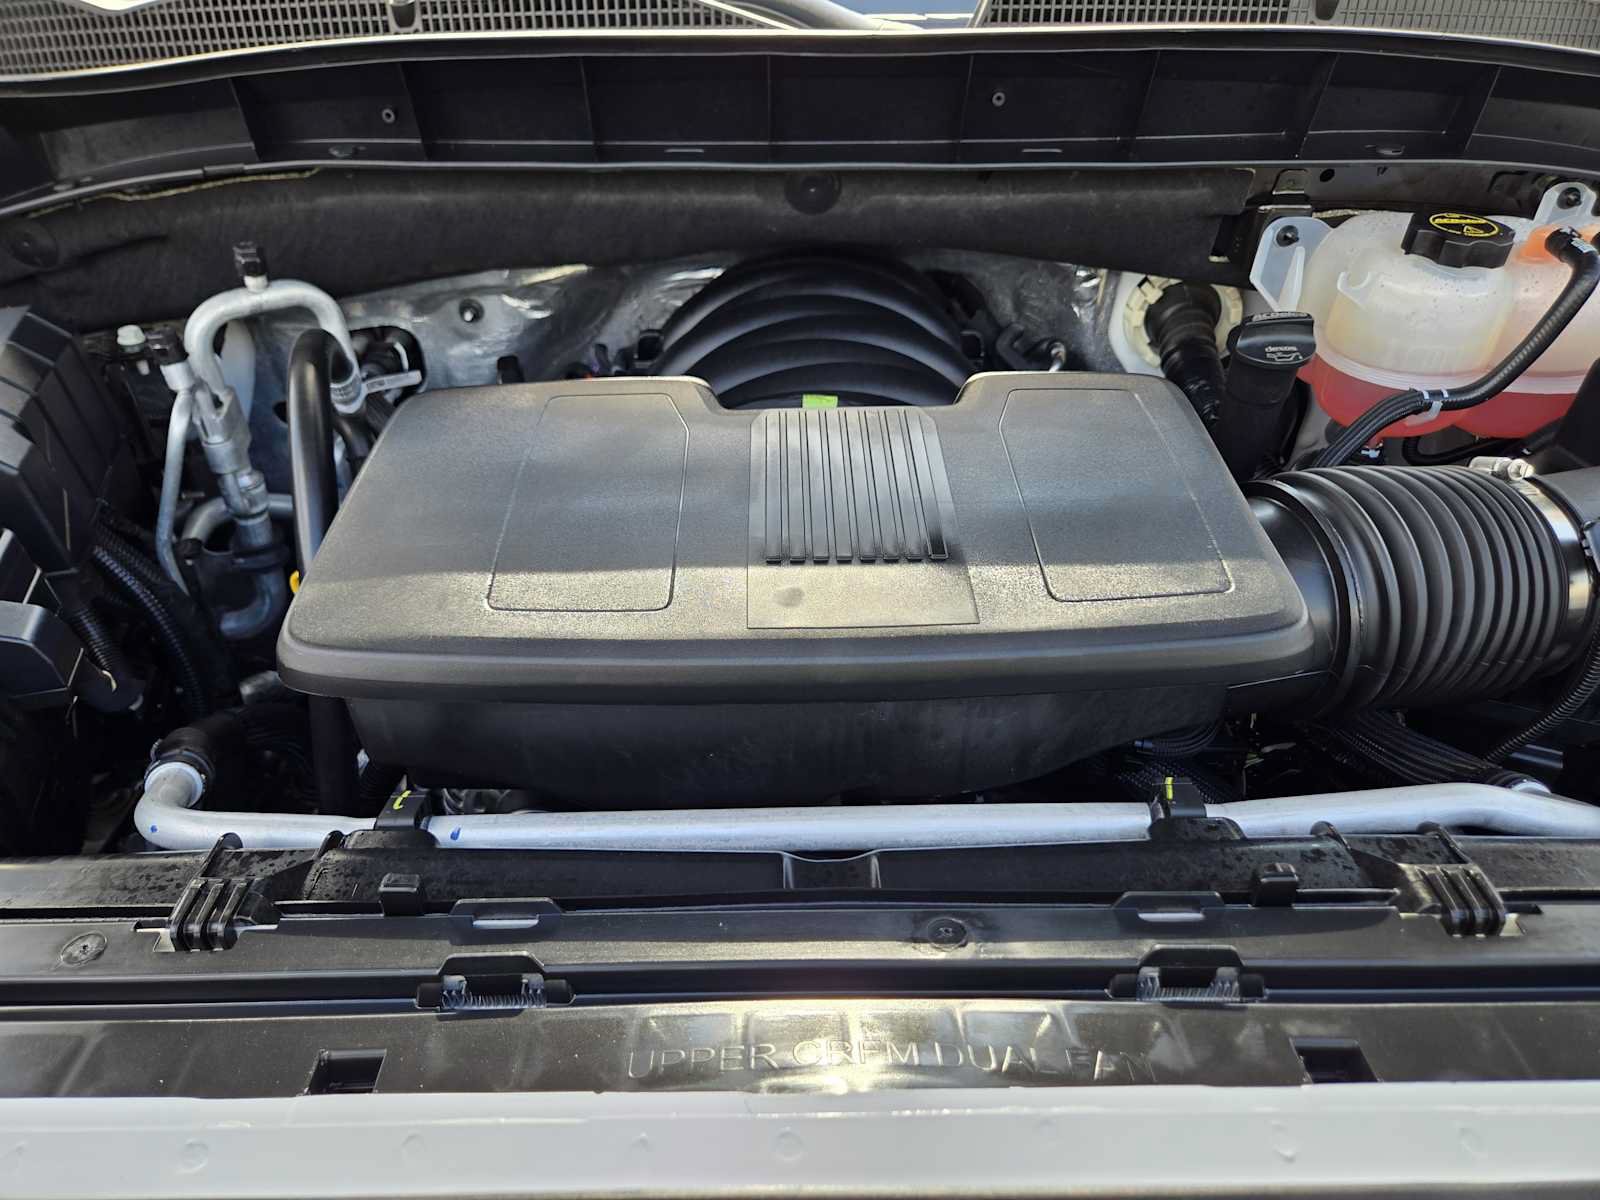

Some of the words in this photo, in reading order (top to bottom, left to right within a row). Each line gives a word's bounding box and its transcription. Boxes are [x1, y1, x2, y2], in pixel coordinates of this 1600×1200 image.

[627, 1043, 780, 1079] UPPER
[792, 1038, 920, 1066] CRFM
[935, 1041, 1058, 1073] DUAL
